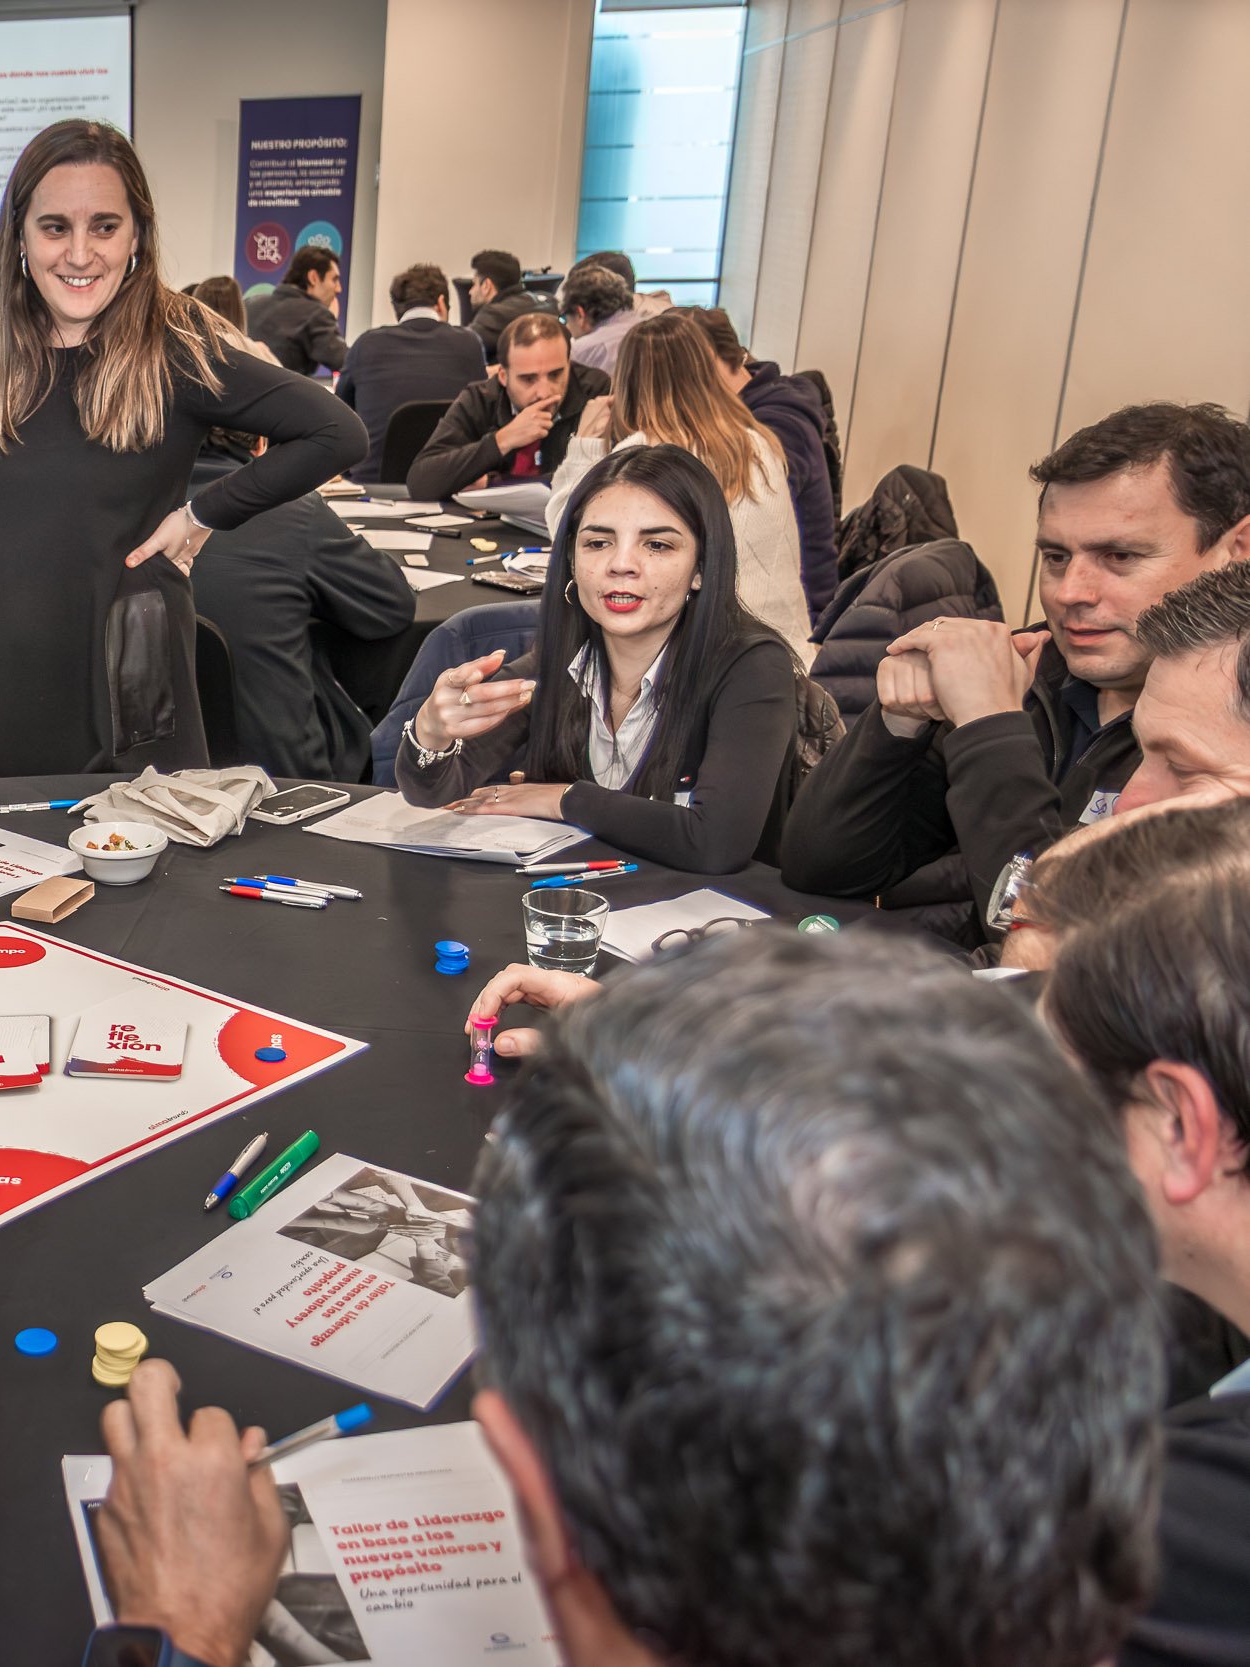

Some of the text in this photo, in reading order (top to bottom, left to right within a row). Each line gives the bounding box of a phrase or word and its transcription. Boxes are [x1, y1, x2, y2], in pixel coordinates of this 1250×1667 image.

[251, 136, 348, 151] NUESTRO PROPÓSITO:
[108, 1031, 140, 1041] fle
[110, 1023, 136, 1032] re
[105, 1040, 161, 1052] xión
[148, 1109, 189, 1131] almabrands
[290, 1251, 313, 1269] cambio
[253, 1256, 329, 1315] Una oportunidad para el
[302, 1261, 347, 1297] propósito
[285, 1267, 362, 1328] nuevos valores y
[322, 1274, 378, 1318] en base a los
[367, 1280, 396, 1302] Taller
[354, 1299, 369, 1311] de
[310, 1310, 359, 1347] Liderazgo
[330, 1509, 506, 1536] Taller de Liderazgo
[337, 1529, 455, 1550] en base a los
[343, 1540, 502, 1566] nuevos valores y
[350, 1561, 443, 1584] propósito
[360, 1572, 522, 1600] Una oportunidad para el
[366, 1599, 414, 1614] cambio
